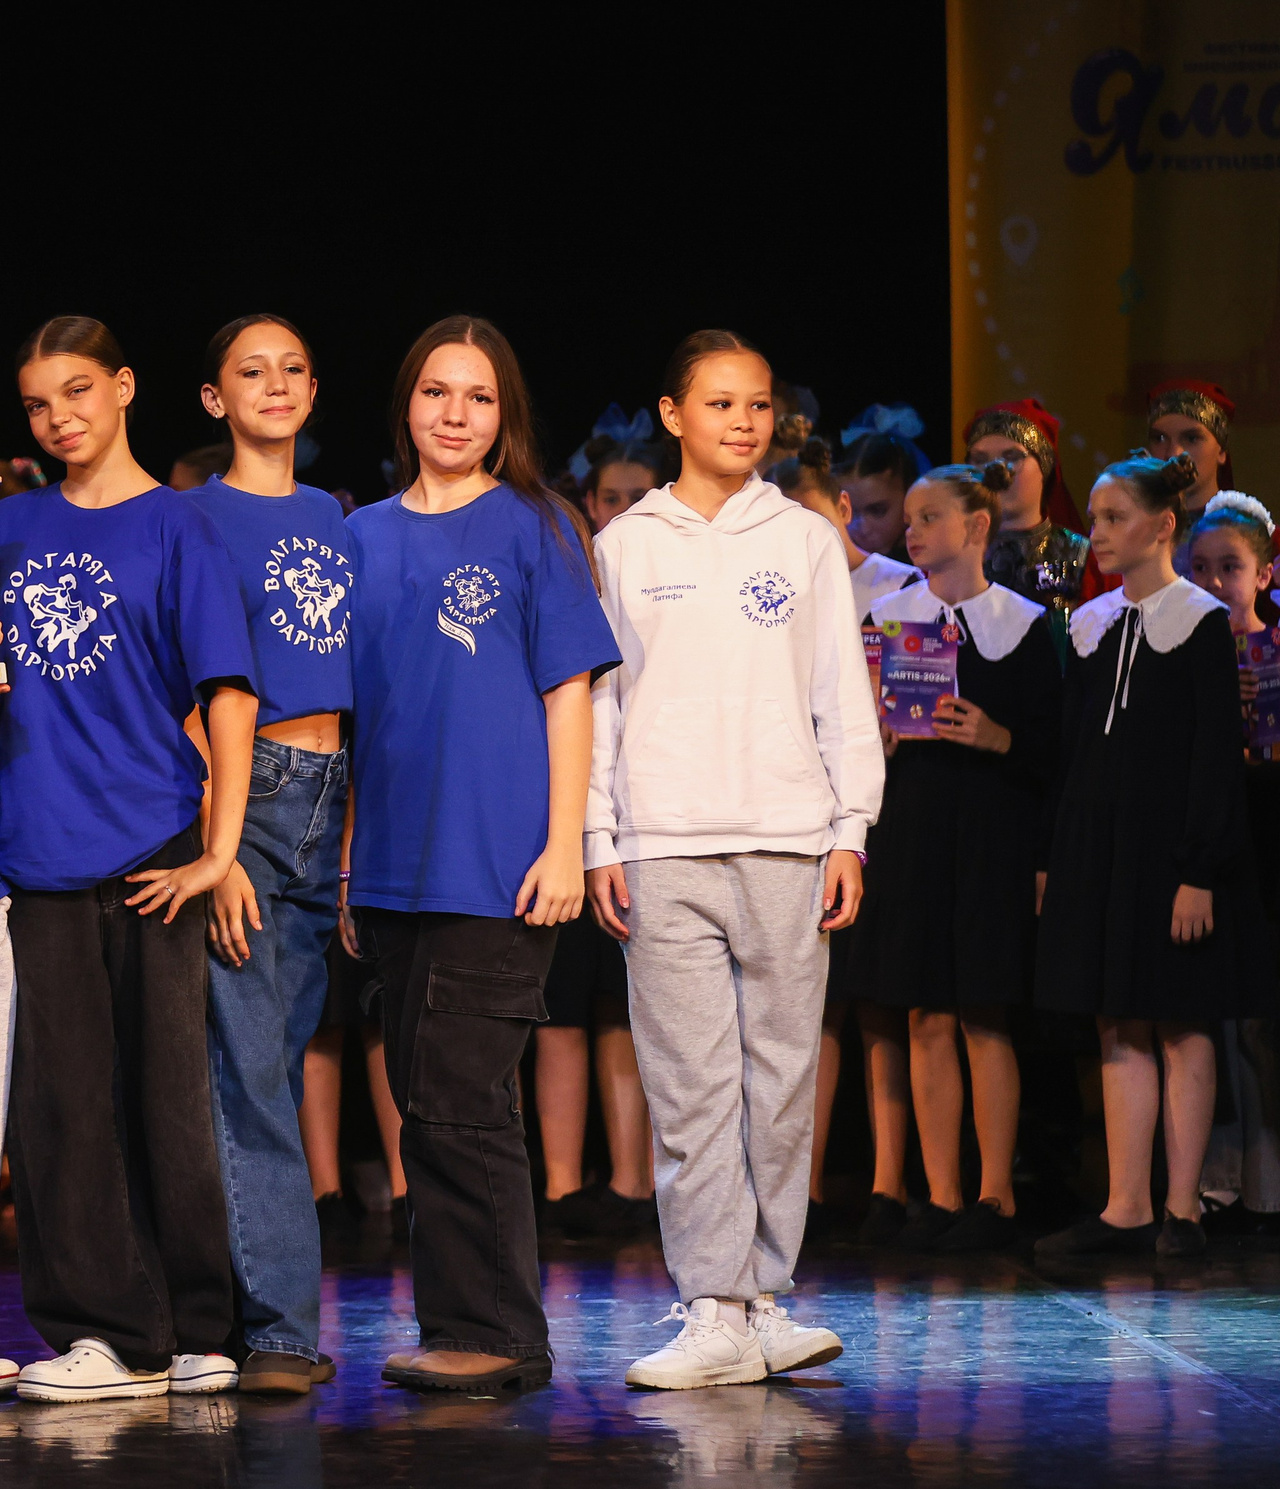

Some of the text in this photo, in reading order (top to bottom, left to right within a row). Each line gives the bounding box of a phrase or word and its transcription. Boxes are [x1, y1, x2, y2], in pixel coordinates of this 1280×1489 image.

[3, 552, 118, 610] ВОЛГАРЯТА
[443, 564, 501, 598] ВОЛГАРЯТА
[739, 570, 796, 598] ВОЛГАРЯТА
[652, 593, 683, 602] Латифа
